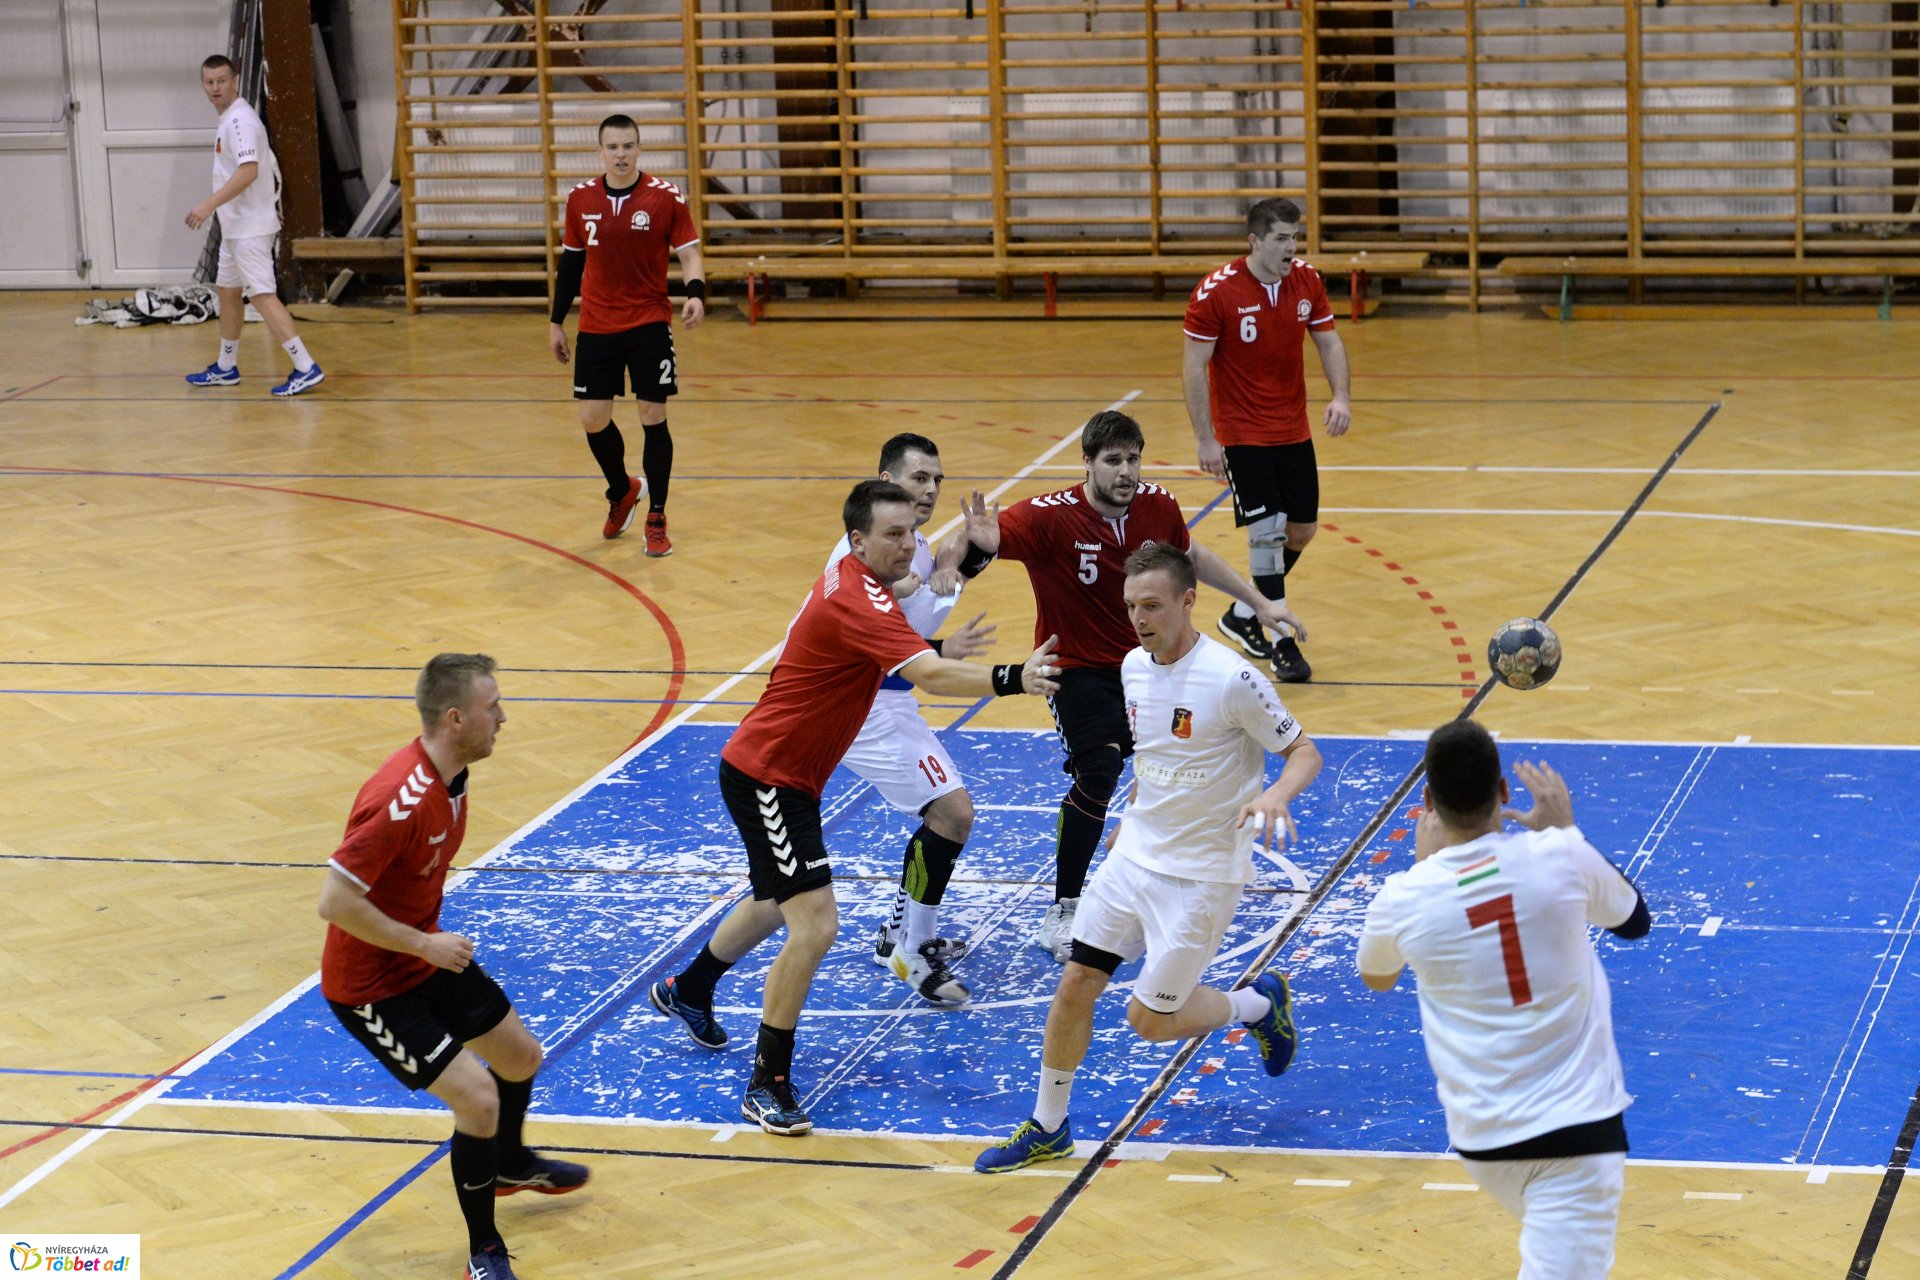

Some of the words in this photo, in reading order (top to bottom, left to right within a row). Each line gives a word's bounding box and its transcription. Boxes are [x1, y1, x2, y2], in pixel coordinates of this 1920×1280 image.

[585, 220, 599, 246] 2
[1240, 315, 1257, 343] 6
[659, 359, 672, 385] 2
[1074, 540, 1102, 551] hummel
[1078, 553, 1098, 585] 5
[918, 755, 947, 788] 19
[1155, 991, 1177, 1002] JAKO
